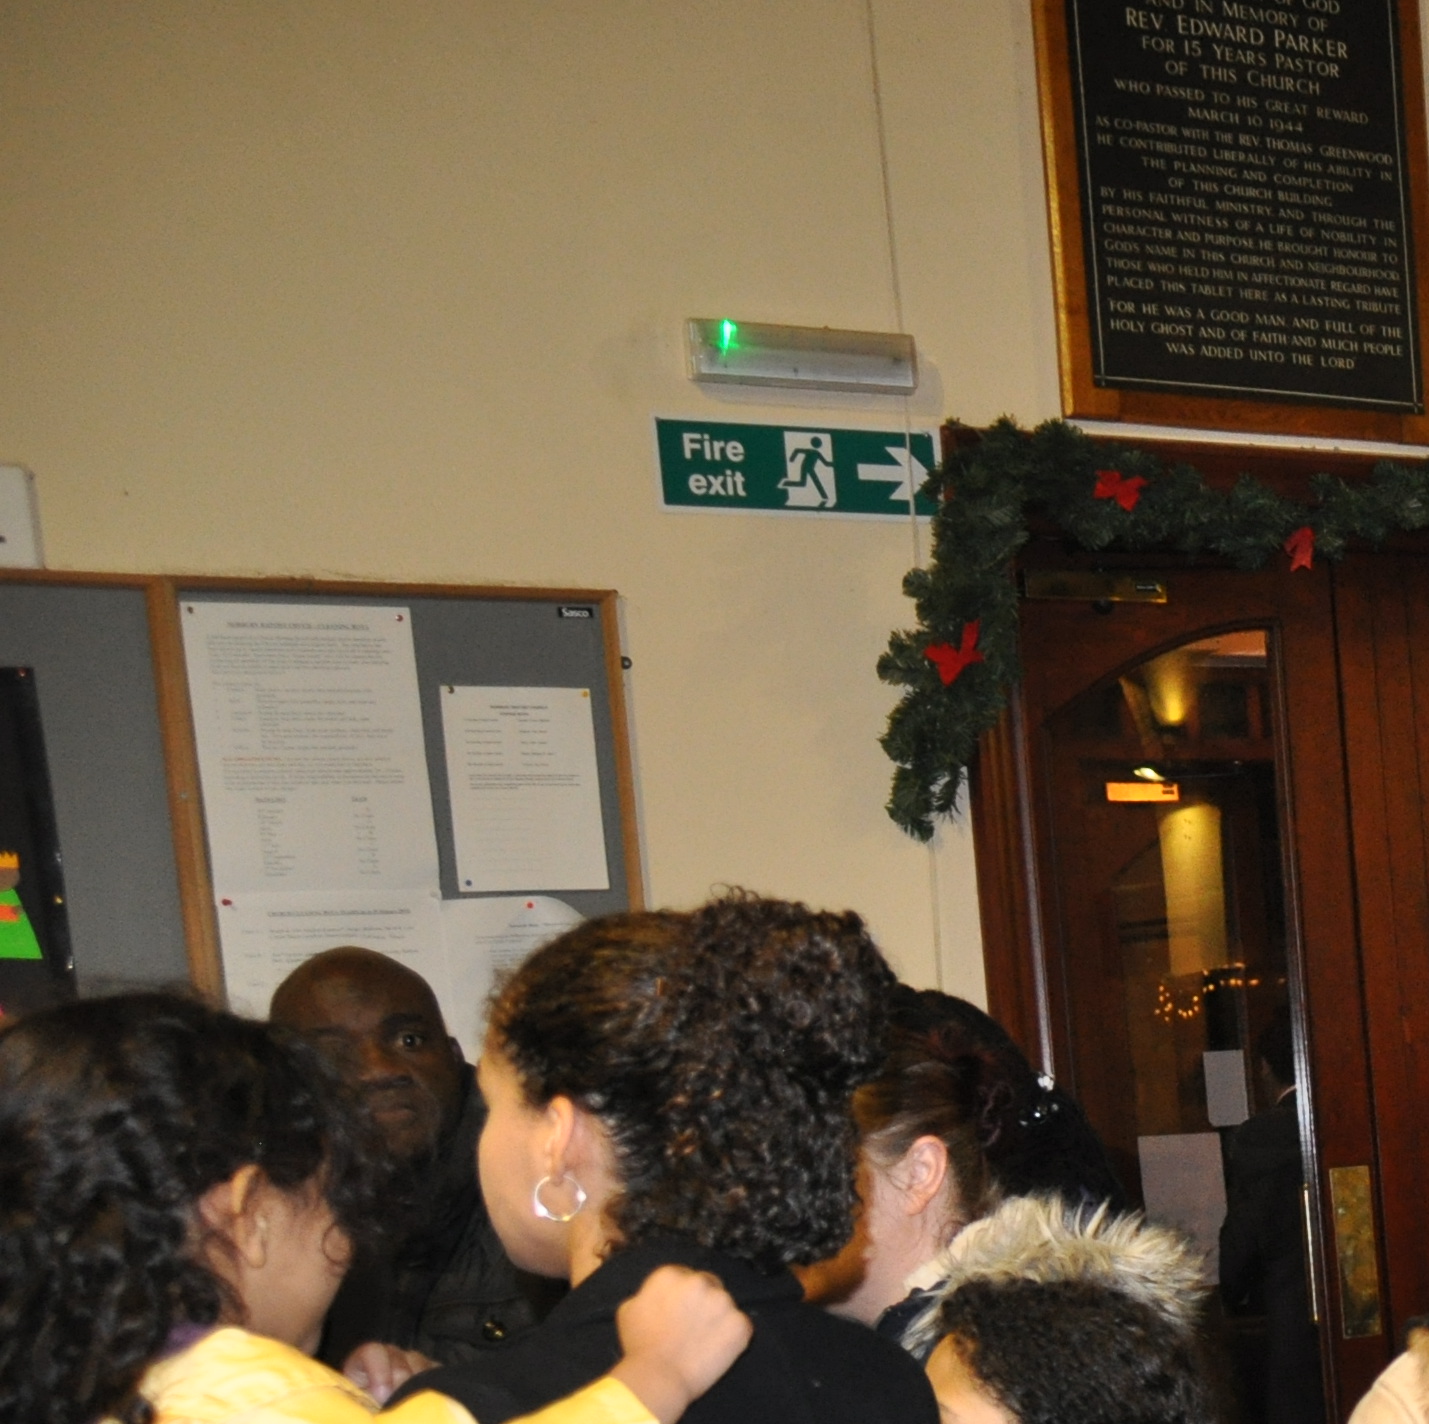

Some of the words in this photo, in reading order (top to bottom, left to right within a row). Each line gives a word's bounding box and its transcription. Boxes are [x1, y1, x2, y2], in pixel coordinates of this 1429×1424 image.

[1176, 13, 1265, 47] EDWARD
[1273, 28, 1348, 59] PARKER
[1221, 0, 1297, 28] MEMORY
[1306, 15, 1327, 32] OF
[1140, 34, 1175, 53] FOR
[1183, 37, 1202, 58] 15
[1211, 43, 1267, 68] YEARS
[1274, 52, 1339, 78] PASTOR
[1163, 58, 1188, 76] OF
[1199, 63, 1237, 84] THIS
[1245, 69, 1320, 96] CHURCH
[1113, 77, 1151, 94] WHO
[1155, 82, 1205, 102] PASSED
[1211, 90, 1231, 105] TO
[1235, 94, 1258, 109] HIS
[1264, 98, 1307, 116] GREAT
[1315, 105, 1369, 124] REWARD
[1187, 105, 1239, 124] MARCH
[1268, 117, 1303, 134] 1944
[1095, 115, 1110, 127] AS
[1180, 126, 1209, 140] WITH
[1213, 130, 1233, 144] THE
[1264, 136, 1313, 154] THOMAS
[1318, 144, 1393, 165] GREENWOOD
[1096, 132, 1112, 145] HE
[1118, 135, 1207, 158] CONTRIBUTED
[1212, 147, 1276, 167] LIBERALLY
[1282, 156, 1298, 169] OF
[1303, 160, 1322, 172] HIS
[1326, 163, 1371, 179] ABILITY
[1379, 170, 1392, 181] IN
[1141, 155, 1165, 169] THE
[1172, 159, 1237, 178] PLANNING
[1241, 168, 1267, 182] AND
[1272, 172, 1353, 193] COMPLETION
[1167, 176, 1184, 189] OF
[1192, 179, 1219, 193] THIS
[1222, 182, 1273, 200] CHURCH
[1276, 189, 1332, 207] BUILDING
[1099, 185, 1116, 198] BY
[1122, 188, 1143, 201] HIS
[1148, 191, 1208, 209] FAITHFUL
[1277, 207, 1305, 221] AND
[1311, 211, 1367, 228] THROUGH
[1373, 218, 1395, 231] THE
[1101, 203, 1166, 221] PERSONAL
[1170, 211, 1229, 229] WITNESS
[1234, 218, 1251, 231] OF
[1254, 221, 1264, 233] A
[1268, 222, 1293, 236] LIFE
[1298, 226, 1314, 238] OF
[1320, 228, 1376, 246] NOBILITY
[1383, 236, 1397, 247] IN
[1102, 220, 1173, 239] CHARACTER
[1175, 229, 1201, 243] AND
[1258, 238, 1273, 251] HE
[1276, 240, 1328, 257] BROUGHT
[1332, 246, 1377, 262] HONOUR
[1381, 252, 1398, 265] TO
[1144, 243, 1177, 258] NAME
[1181, 247, 1196, 259] IN
[1199, 248, 1226, 262] THIS
[1229, 251, 1276, 268] CHURCH
[1278, 257, 1304, 271] AND
[1306, 260, 1400, 281] NEIGHBOURHOOD
[1105, 256, 1142, 271] THOSE
[1146, 260, 1175, 274] WHO
[1177, 263, 1210, 278] HELD
[1211, 267, 1234, 280] HIM
[1235, 270, 1249, 282] IN
[1250, 271, 1326, 290] AFFECTIONATE
[1329, 279, 1371, 295] REGARD
[1372, 284, 1399, 298] HAVE
[1105, 273, 1155, 290] PLACED
[1159, 279, 1186, 293] THIS
[1190, 282, 1233, 298] TABLET
[1238, 286, 1268, 301] HERE
[1273, 290, 1288, 303] AS
[1289, 292, 1299, 304] A
[1301, 293, 1351, 309] LASTING
[1354, 298, 1401, 315] TRIBUTE
[1109, 317, 1145, 333] HOLY
[1149, 320, 1194, 337] GHOST
[1197, 325, 1226, 340] AND
[1229, 327, 1248, 342] OF
[1289, 333, 1317, 348] AND
[1319, 336, 1359, 352] MUCH
[1362, 340, 1403, 357] PEOPLE
[1140, 301, 1159, 316] HE
[1163, 304, 1192, 318] WAS
[1195, 307, 1206, 320] A
[1208, 308, 1250, 324] GOOD
[1291, 315, 1320, 331] AND
[1323, 319, 1355, 334] FULL
[1358, 322, 1376, 336] OF
[1380, 324, 1403, 339] THE
[1164, 341, 1196, 356] WAS
[1198, 343, 1244, 360] ADDED
[1248, 348, 1285, 363] UNTO
[1290, 351, 1313, 366] THE
[682, 432, 745, 462] Fire
[688, 470, 746, 497] exit
